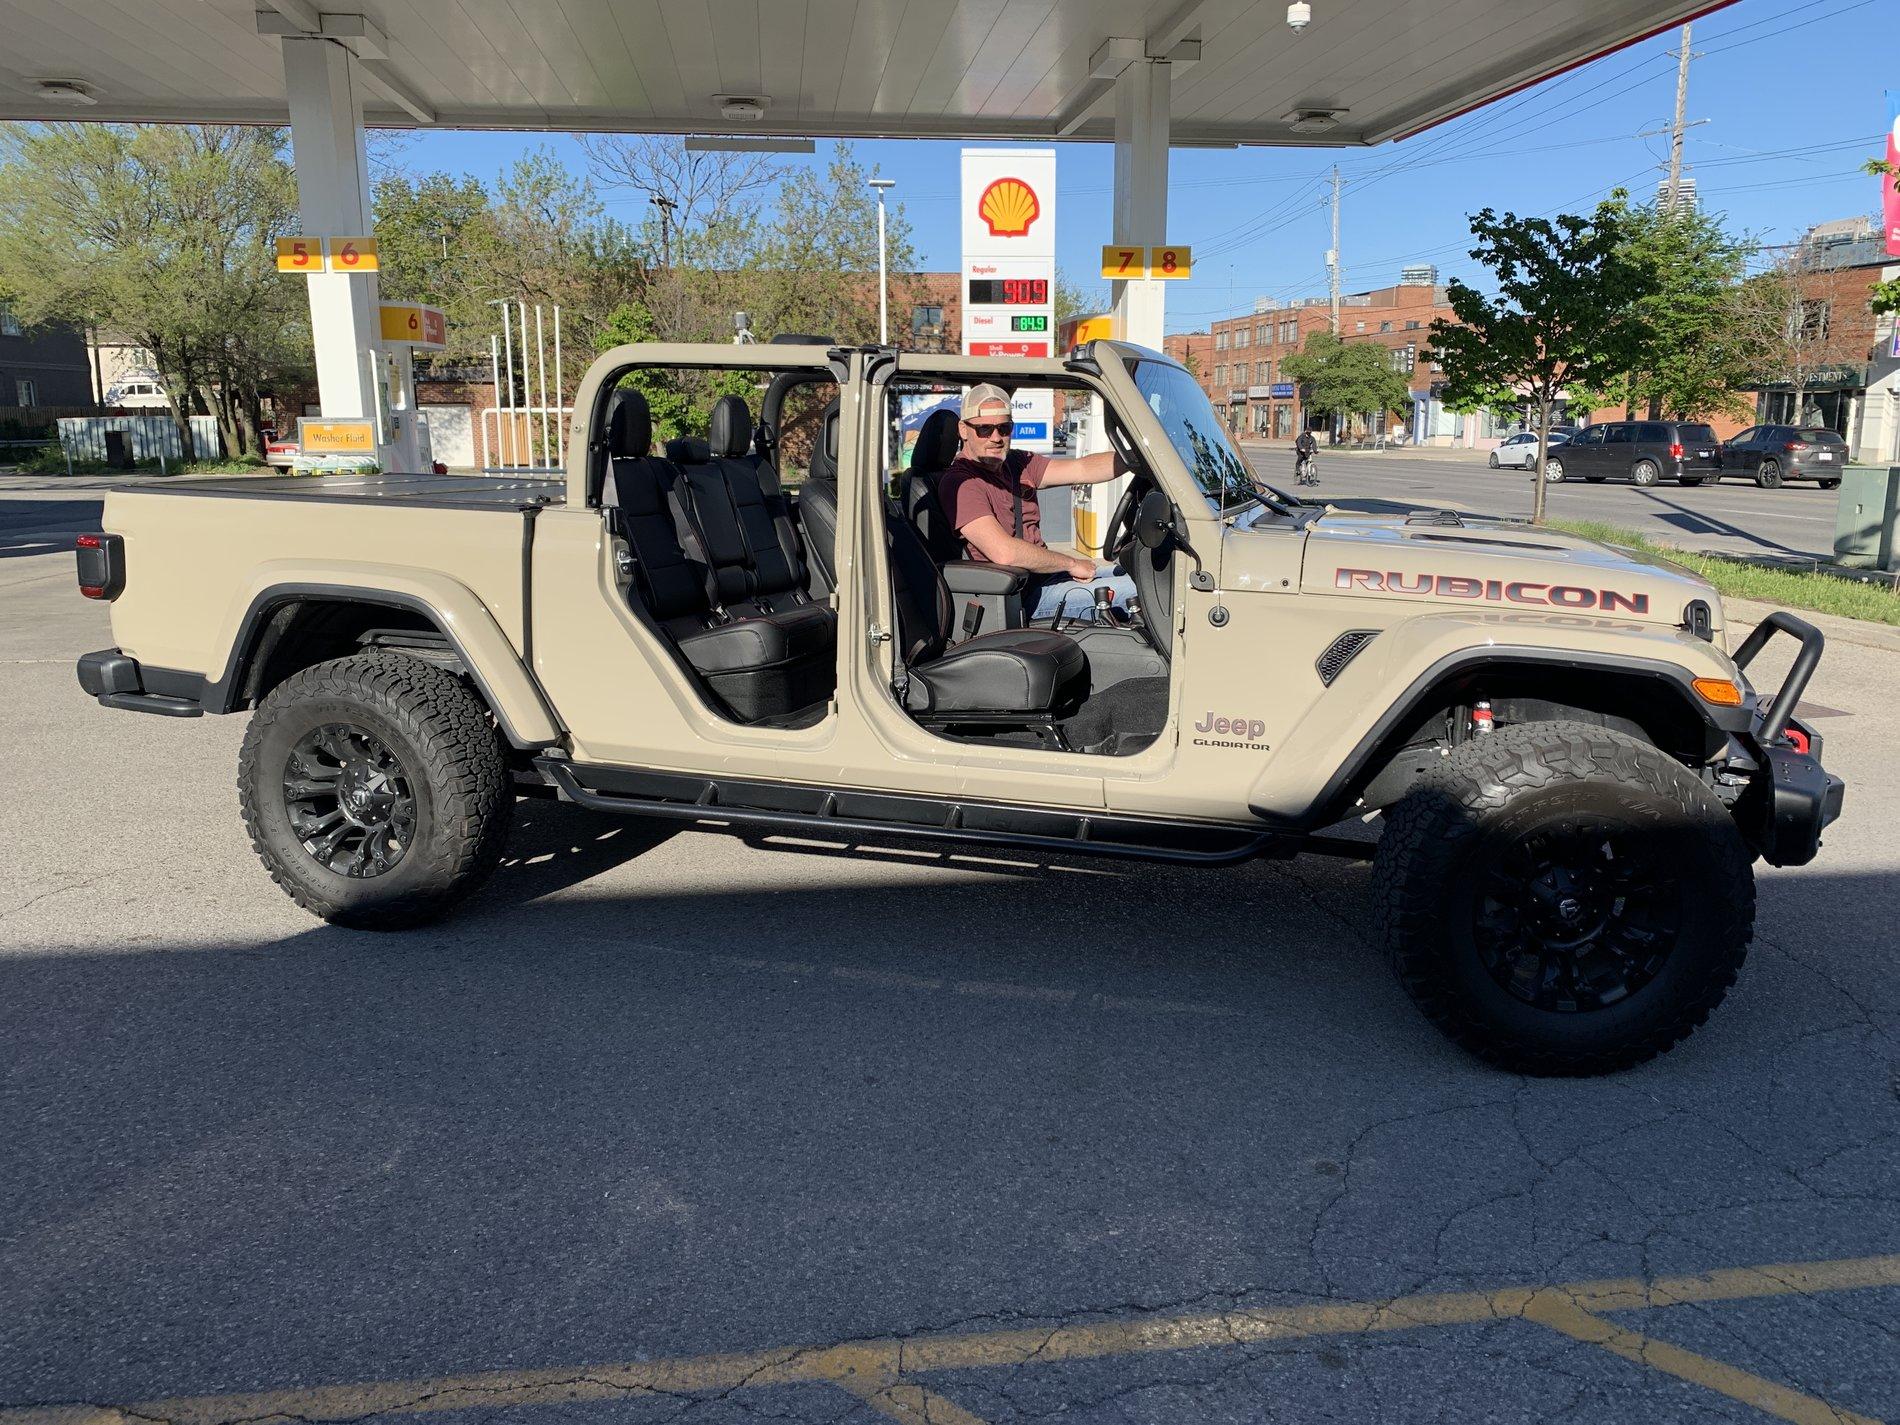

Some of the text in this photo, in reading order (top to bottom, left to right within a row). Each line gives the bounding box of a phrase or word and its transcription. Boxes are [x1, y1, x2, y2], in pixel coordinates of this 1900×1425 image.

[293, 243, 308, 265] 5
[341, 242, 359, 265] 6
[972, 265, 997, 274] Regular
[1119, 252, 1134, 272] 7
[1162, 251, 1176, 273] 8
[408, 313, 418, 329] 6
[974, 316, 993, 325] Diesel
[1082, 325, 1089, 341] 7
[1010, 402, 1033, 410] elect
[313, 433, 343, 443] Washer
[1019, 427, 1036, 435] ATM
[1335, 567, 1649, 614] RUBICON
[1195, 710, 1266, 741] Jeep
[1193, 738, 1270, 751] GLADIATOR
